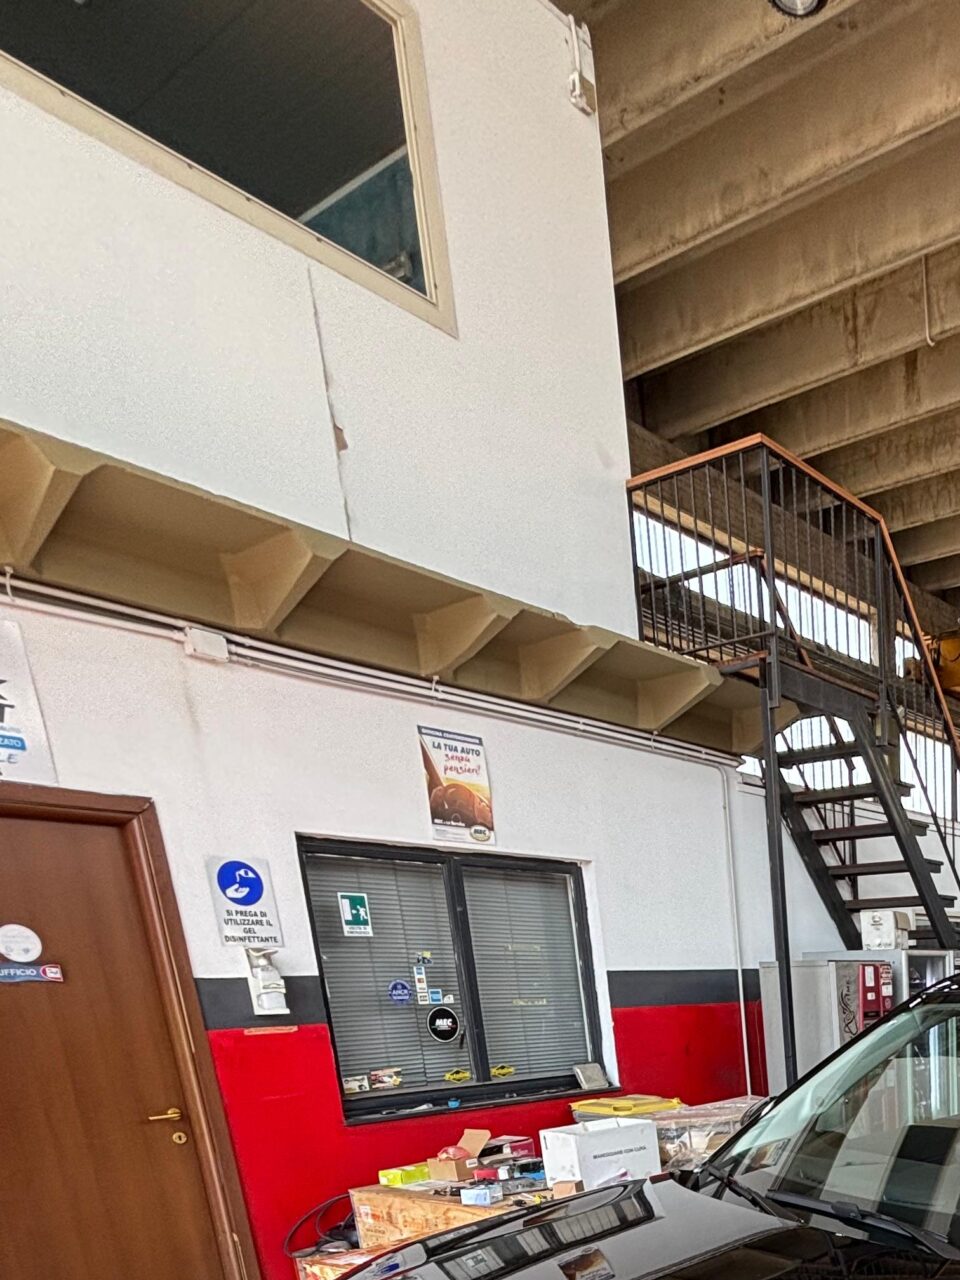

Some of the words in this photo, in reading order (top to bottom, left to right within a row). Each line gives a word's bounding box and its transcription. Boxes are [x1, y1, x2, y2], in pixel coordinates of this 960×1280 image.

[432, 741, 442, 750] LA
[443, 743, 459, 753] TUA
[460, 746, 481, 757] AUTO
[226, 909, 234, 917] SI
[235, 909, 259, 918] PREGA
[260, 910, 268, 918] DI
[223, 918, 265, 927] UTILIZZARE
[265, 919, 273, 927] IL
[242, 927, 257, 935] GEL
[224, 935, 279, 944] DISINFETTANTE
[435, 1018, 453, 1026] MEC
